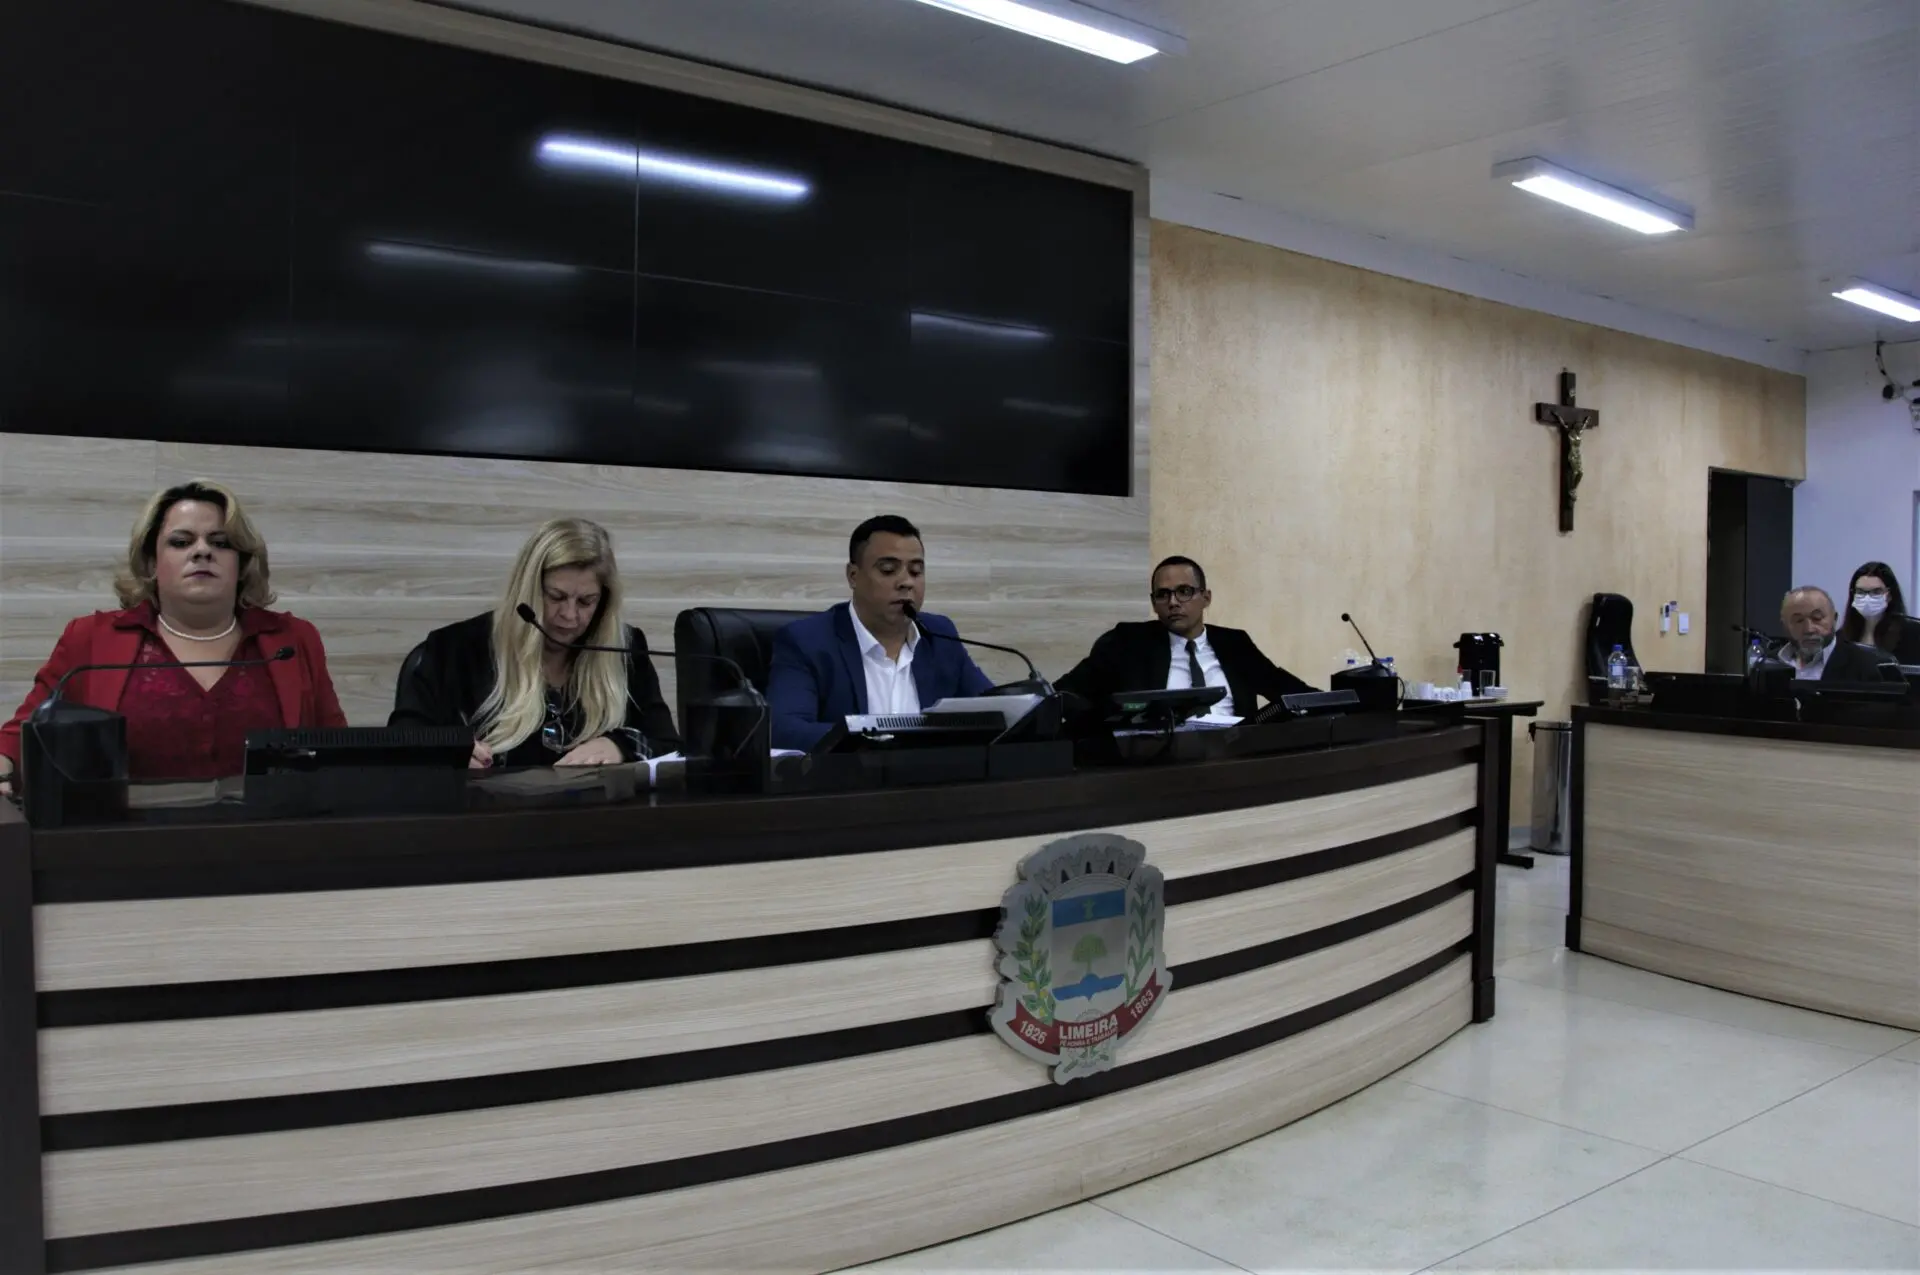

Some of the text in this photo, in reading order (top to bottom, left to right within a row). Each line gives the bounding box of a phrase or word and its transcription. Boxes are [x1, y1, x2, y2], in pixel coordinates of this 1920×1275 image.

[1130, 990, 1154, 1018] 1863
[1019, 1020, 1048, 1045] 1826
[1059, 1014, 1118, 1039] LIMEIRA
